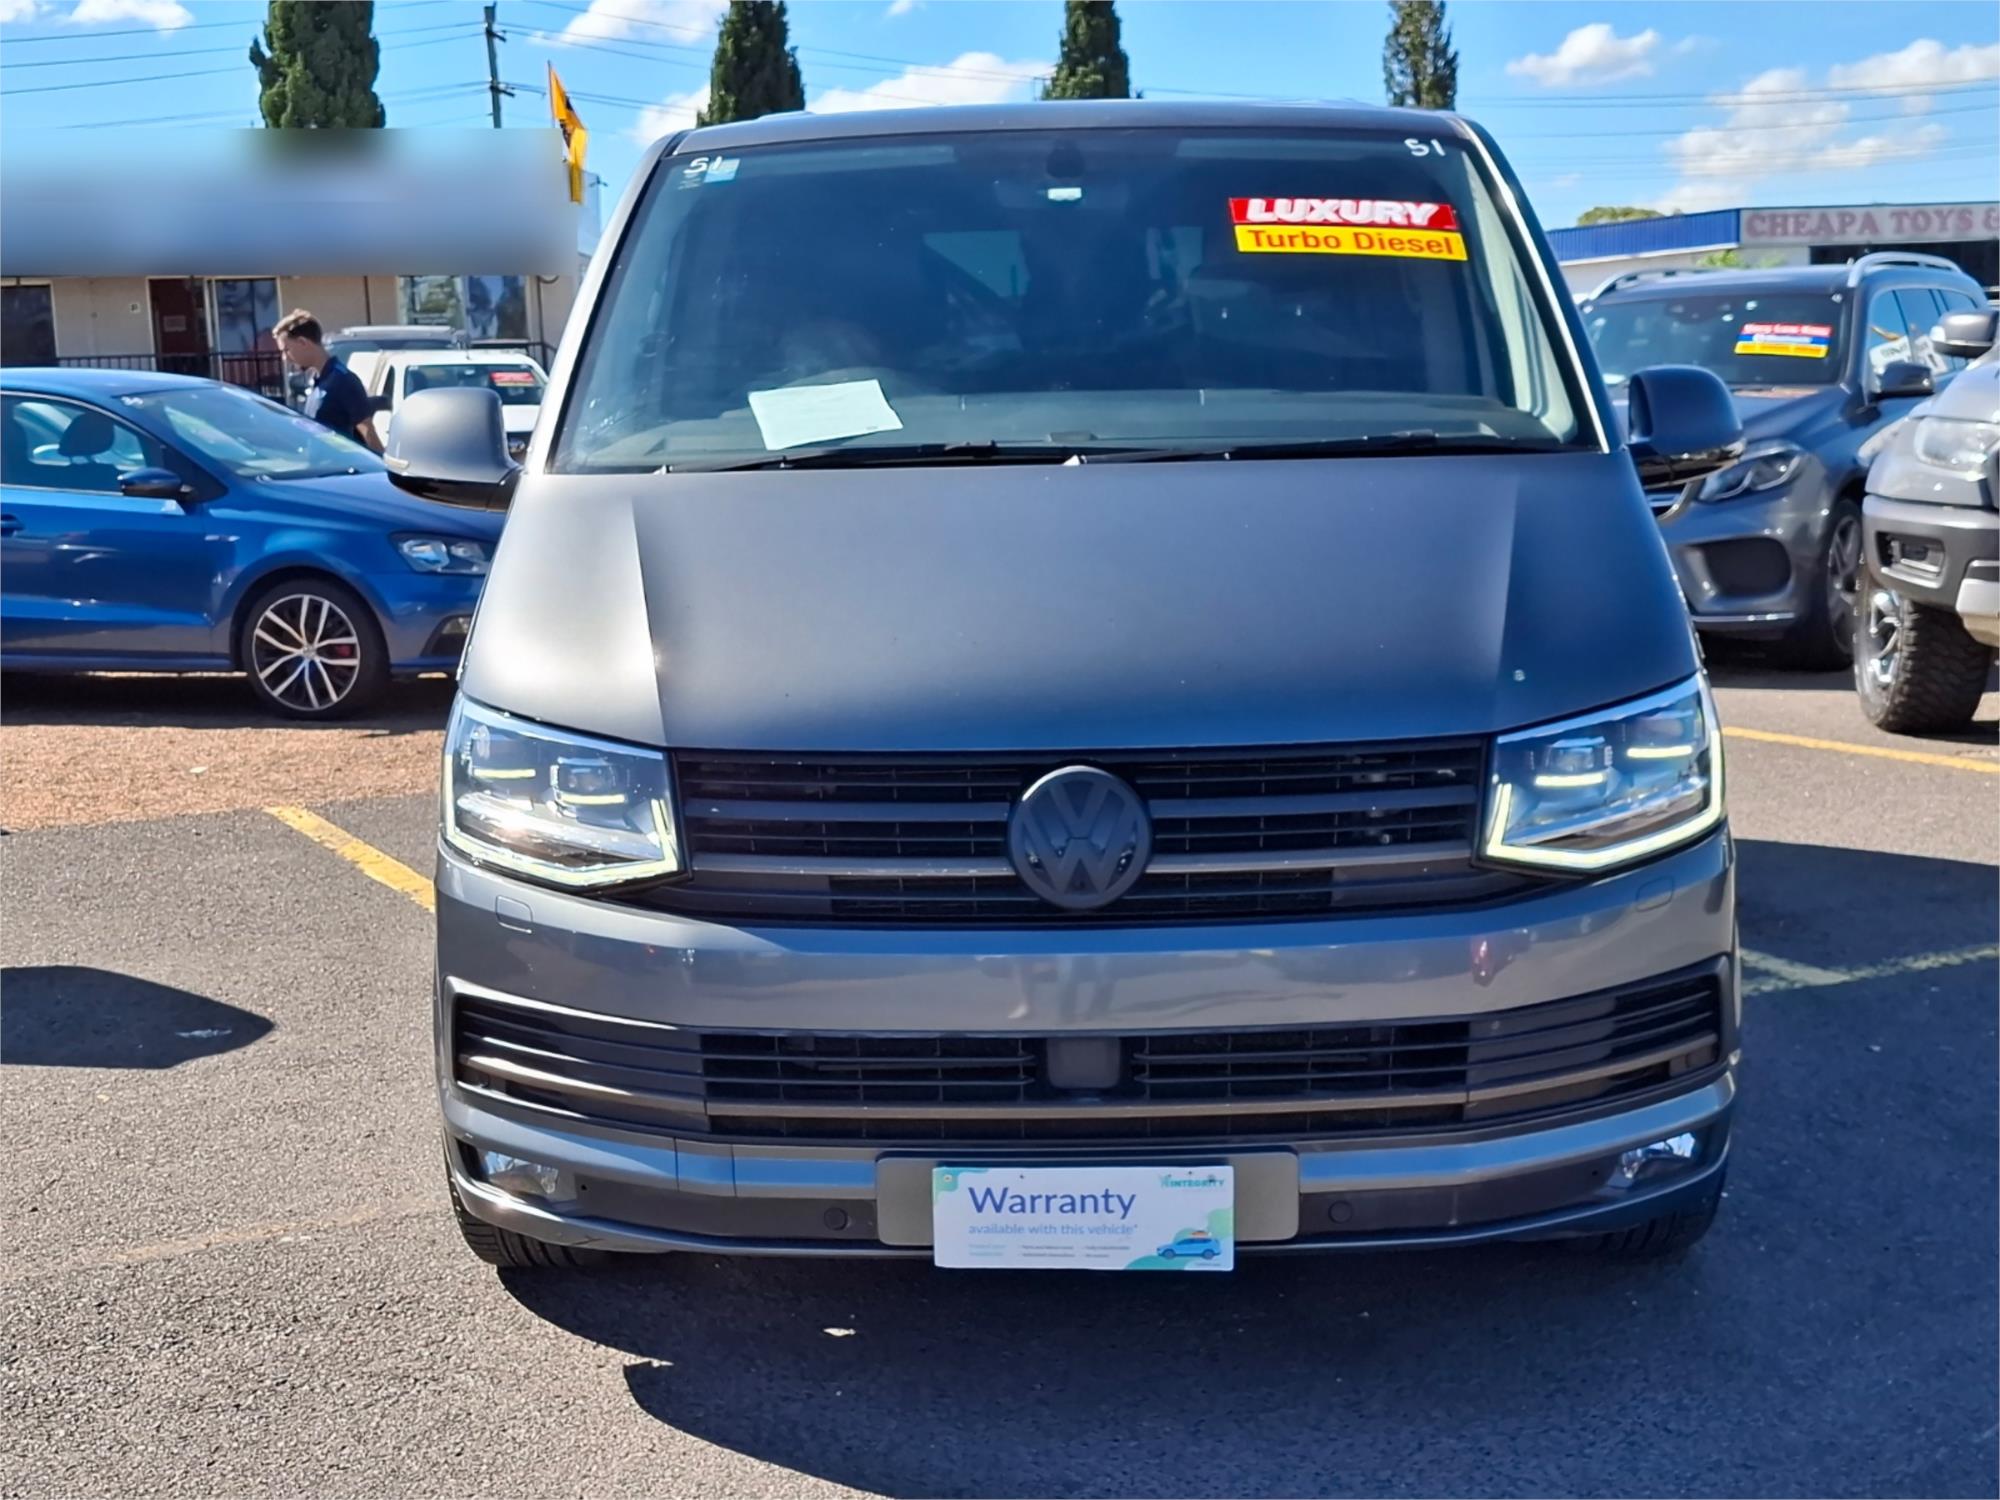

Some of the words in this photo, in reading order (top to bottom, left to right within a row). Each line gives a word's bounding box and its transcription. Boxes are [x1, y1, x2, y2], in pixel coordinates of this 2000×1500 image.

[1246, 198, 1439, 225] LUXURY
[1746, 211, 1879, 237] CHEAPA
[1890, 208, 1974, 234] TOYS
[1248, 229, 1342, 250] Turbo
[1352, 231, 1453, 254] Diesel
[968, 1187, 1136, 1220] Warranty
[968, 1224, 1025, 1235] available
[1027, 1224, 1057, 1235] with
[1061, 1224, 1085, 1235] this
